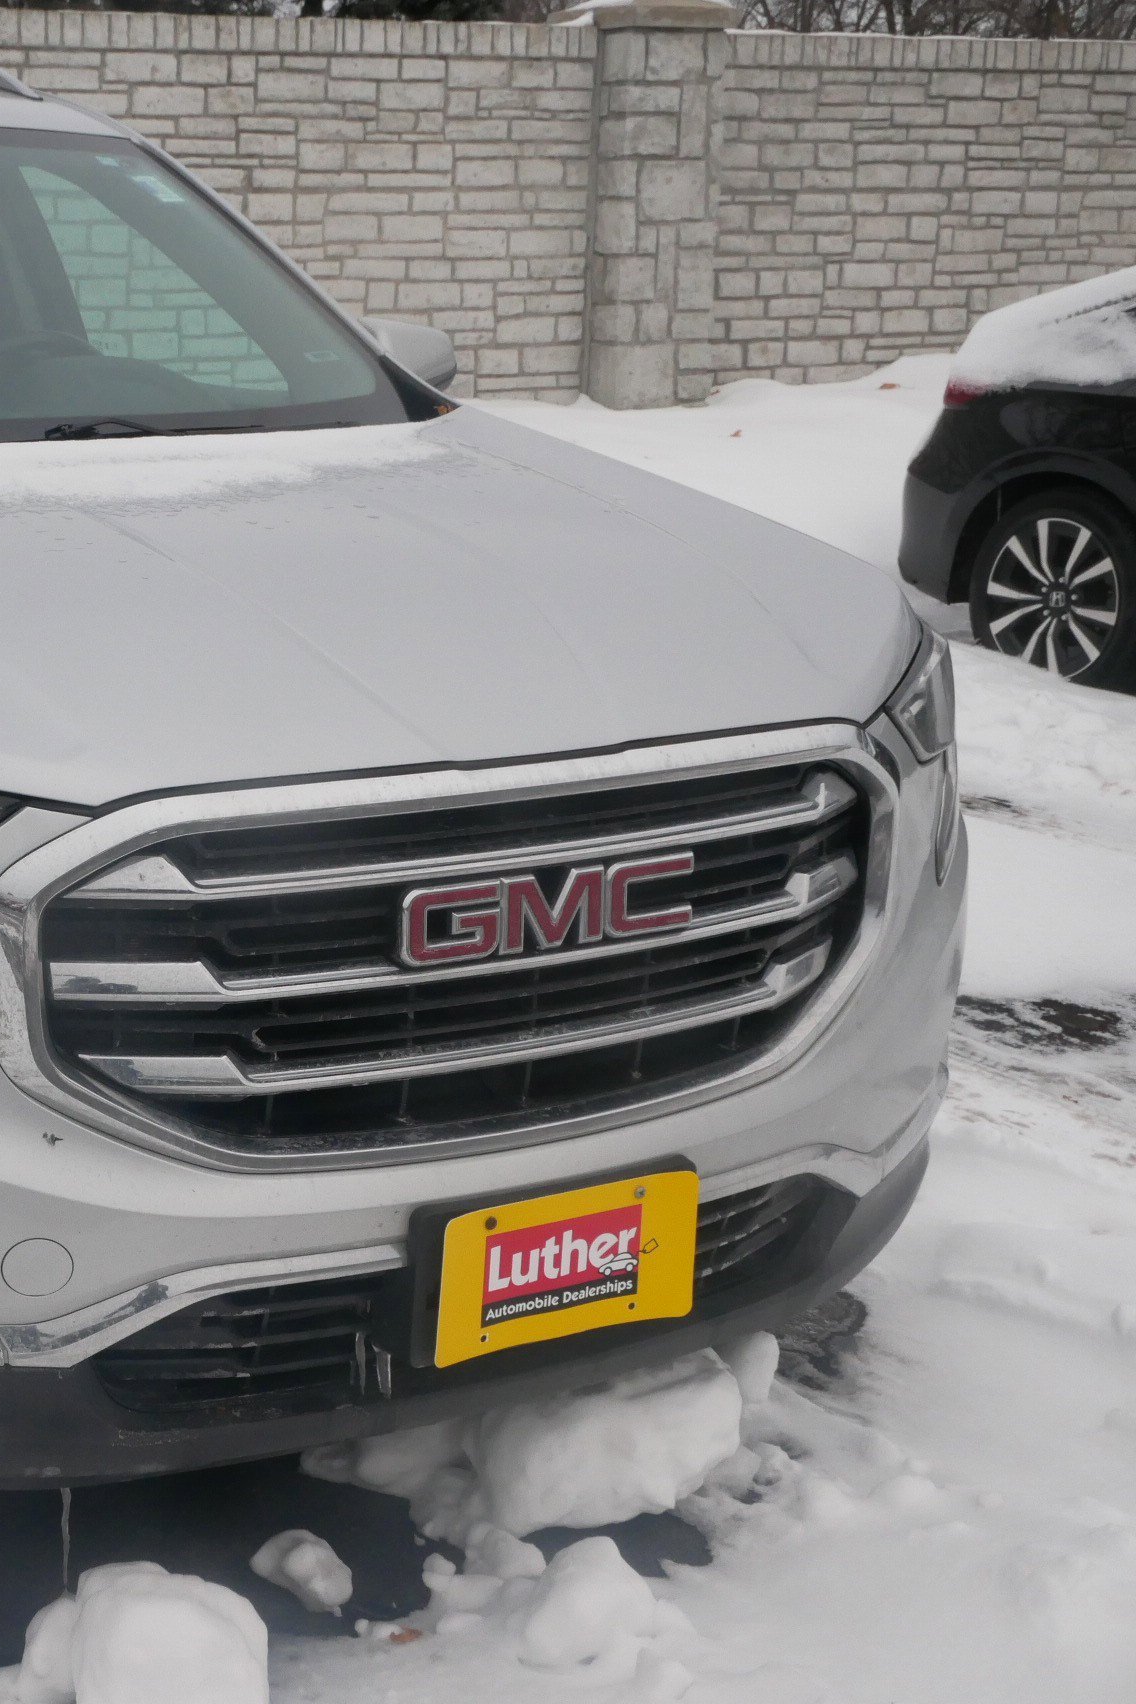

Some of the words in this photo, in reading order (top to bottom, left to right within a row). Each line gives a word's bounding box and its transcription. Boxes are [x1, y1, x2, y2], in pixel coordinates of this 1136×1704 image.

[400, 851, 694, 966] GMC
[487, 1226, 638, 1292] Luther
[485, 1294, 559, 1321] Automobile
[562, 1278, 633, 1304] Dealerships
